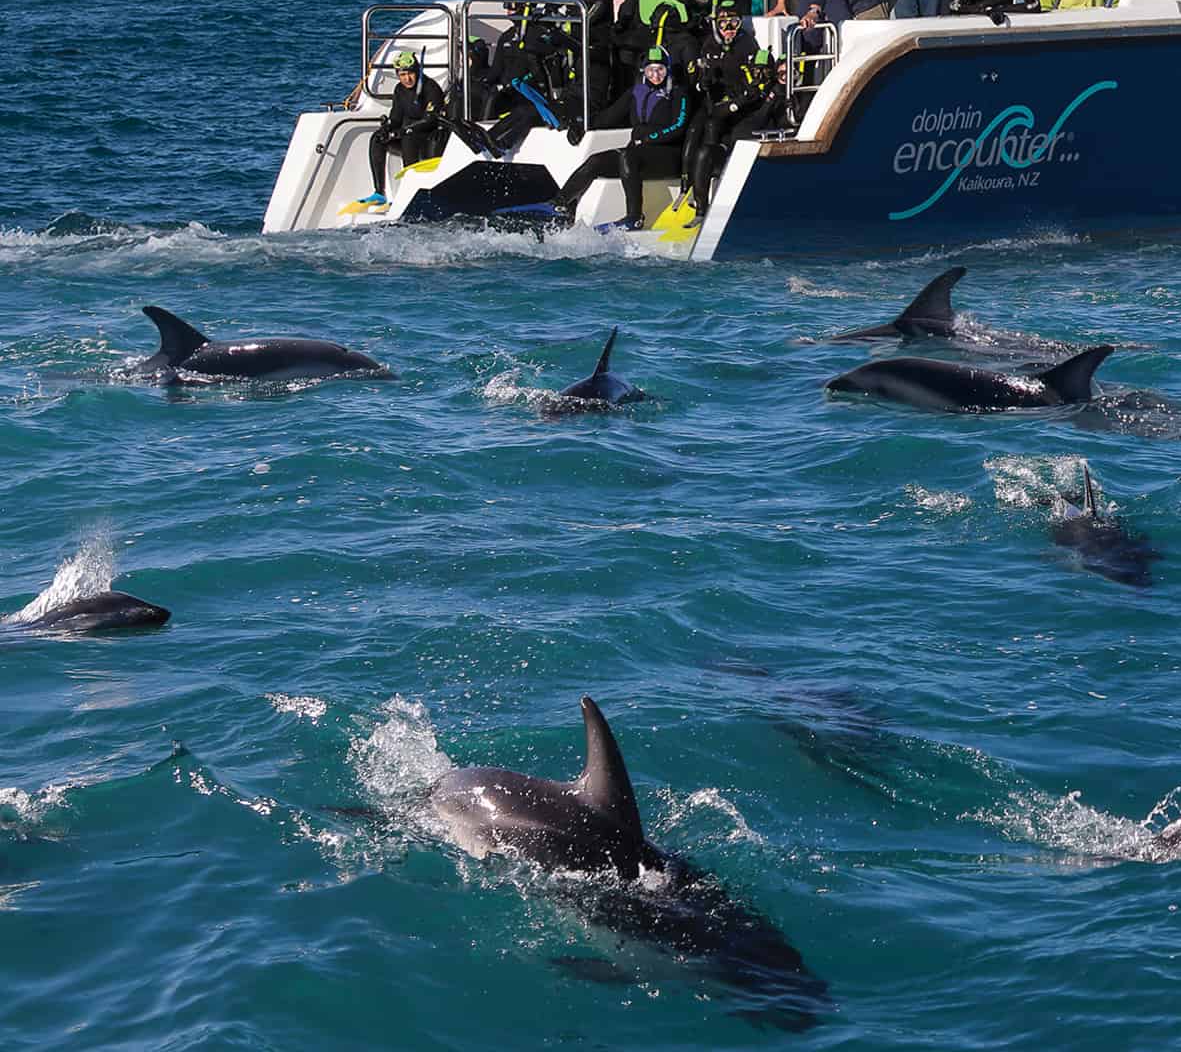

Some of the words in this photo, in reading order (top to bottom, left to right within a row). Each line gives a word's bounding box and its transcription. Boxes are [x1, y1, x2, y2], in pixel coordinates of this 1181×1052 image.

[911, 104, 983, 137] dolphin
[957, 174, 1016, 192] Kaikoura,
[1017, 171, 1041, 187] NZ
